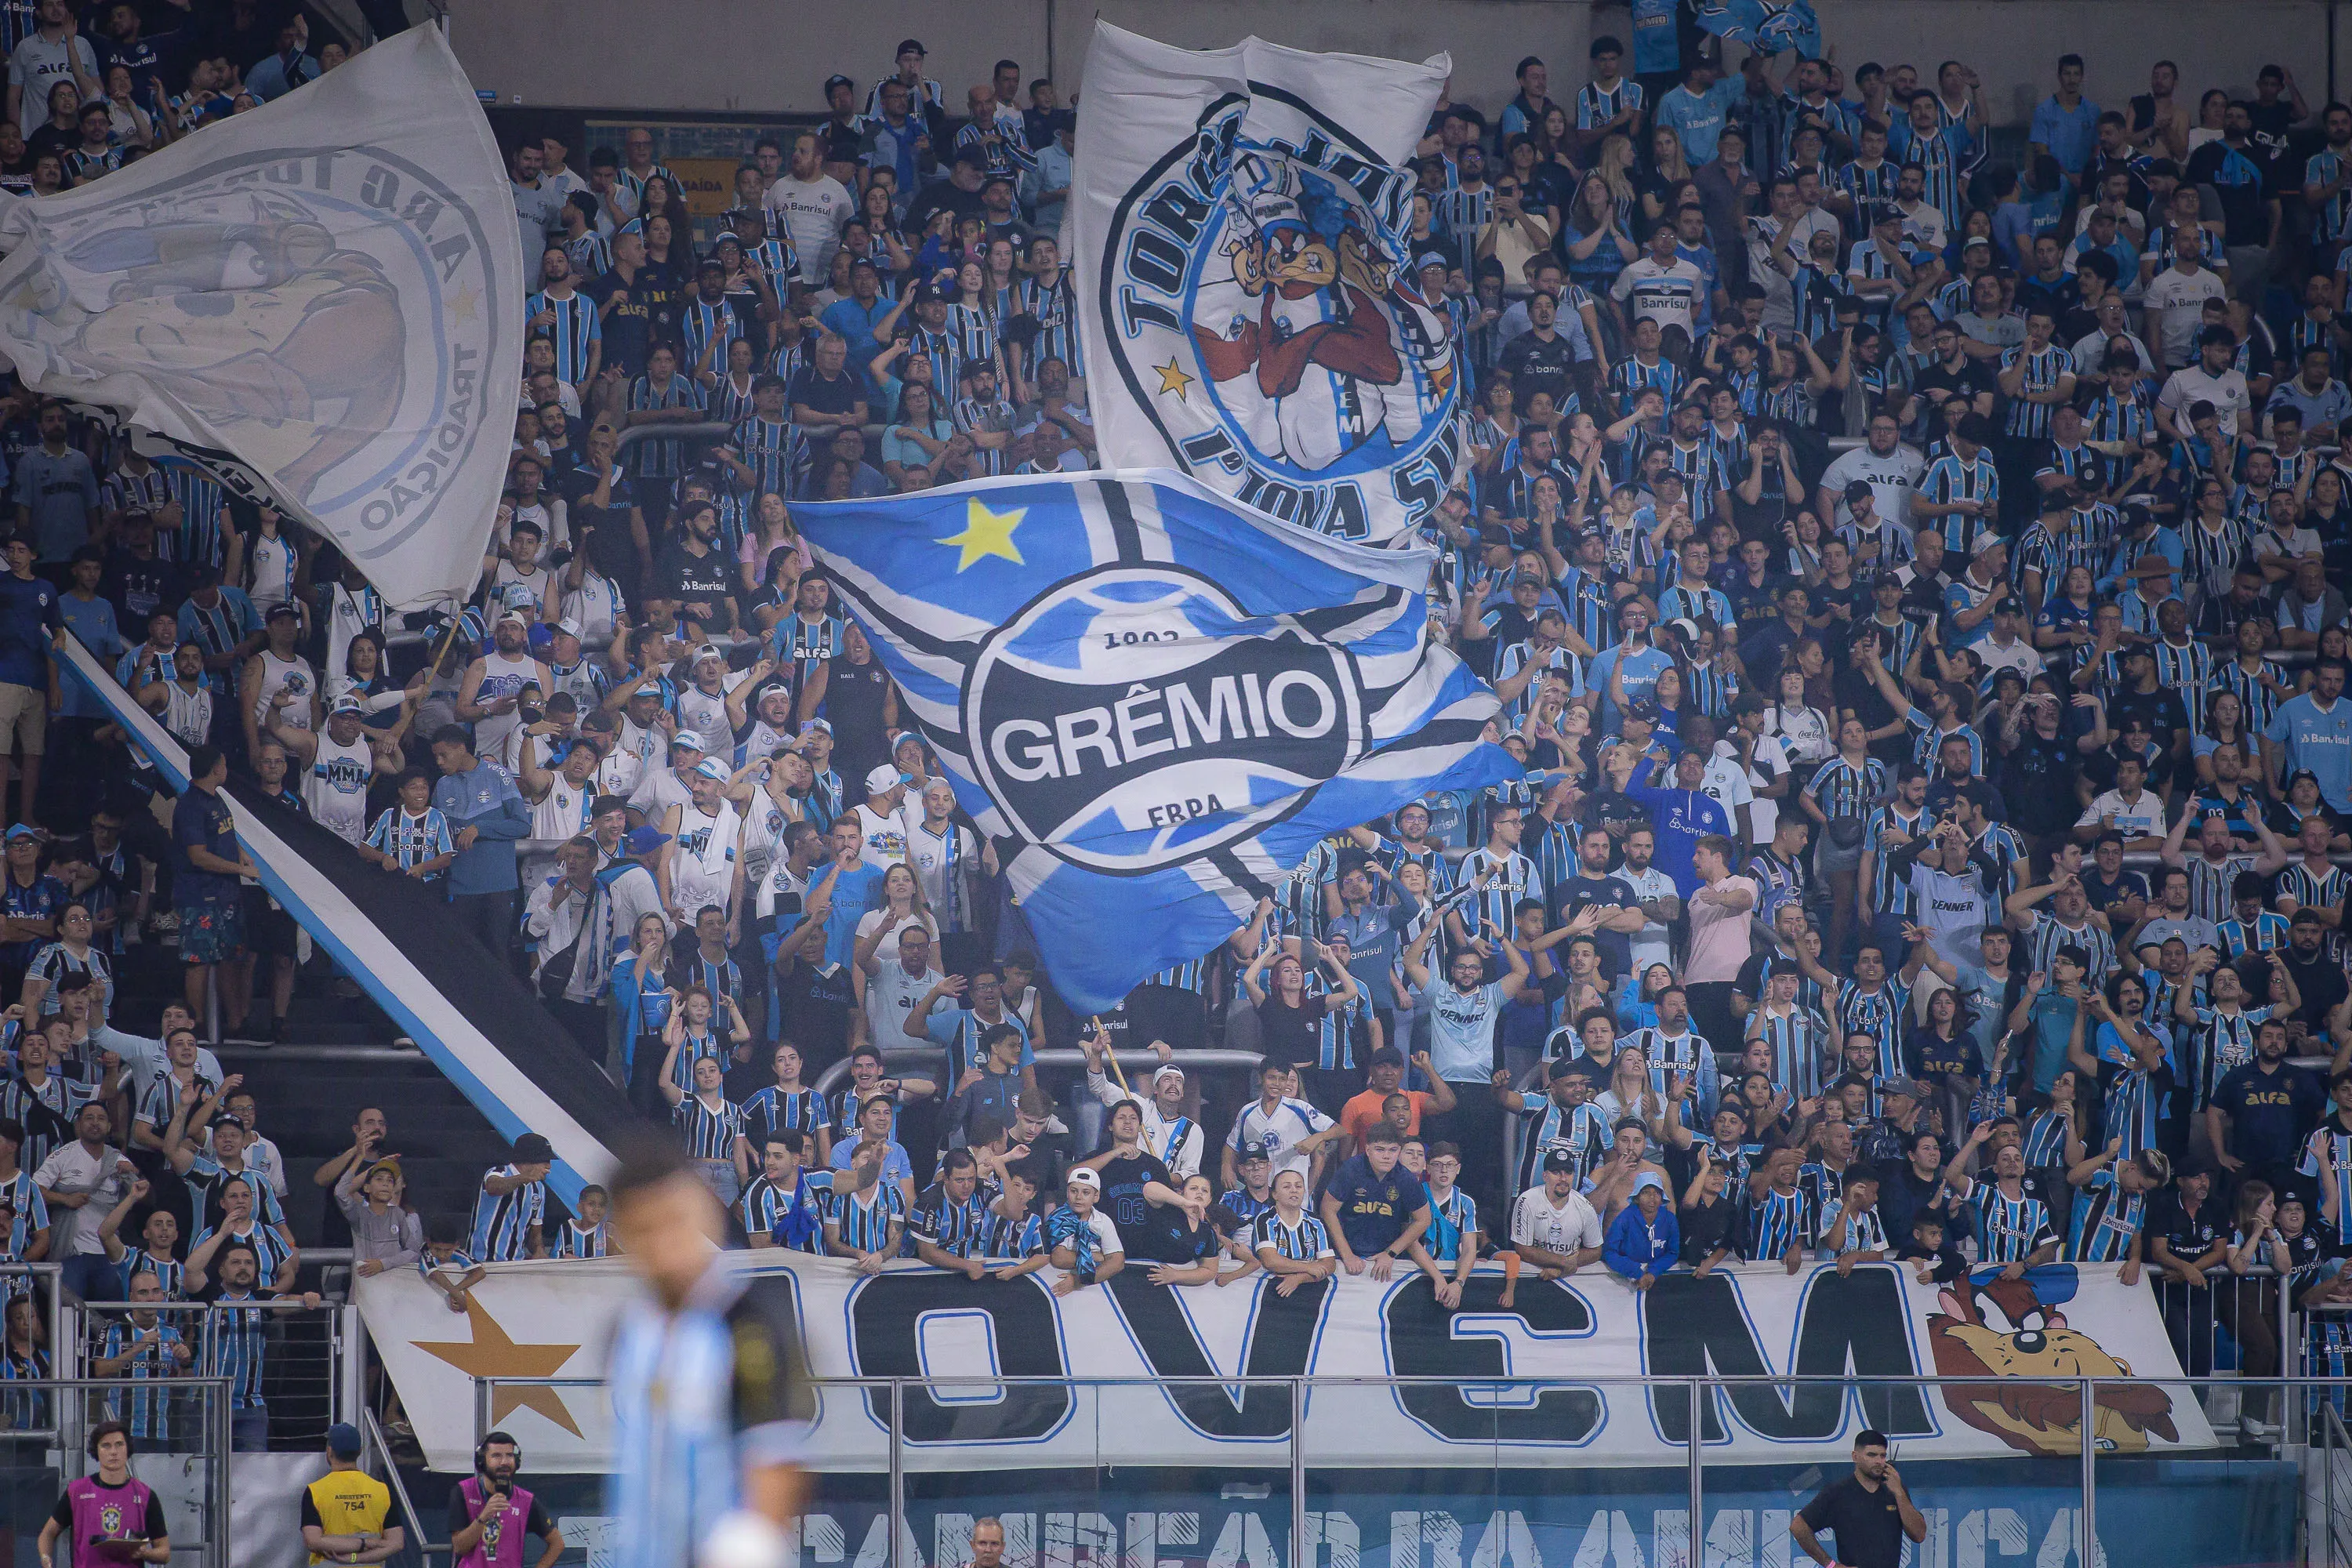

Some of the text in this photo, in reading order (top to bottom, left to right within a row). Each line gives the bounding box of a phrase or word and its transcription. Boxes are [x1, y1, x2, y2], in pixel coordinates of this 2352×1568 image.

[790, 201, 830, 216] Banrisul
[1865, 473, 1907, 487] alfa
[2036, 527, 2045, 547] vero
[692, 581, 727, 593] Banrisul
[793, 647, 832, 660] alfa
[990, 670, 1337, 782] GRÊMIO
[2311, 733, 2350, 746] Banrisul
[327, 765, 364, 786] MMA
[488, 762, 507, 777] vero
[1931, 899, 1973, 913] RENNER
[1349, 945, 1383, 960] anrisul
[1652, 1058, 1696, 1072] Banrisul
[1922, 1061, 1964, 1073] alfa
[2245, 1091, 2291, 1105] alfa
[1116, 1197, 1145, 1225] 03
[1515, 1196, 1527, 1237] TRAMONTINA
[344, 1501, 365, 1511] 754
